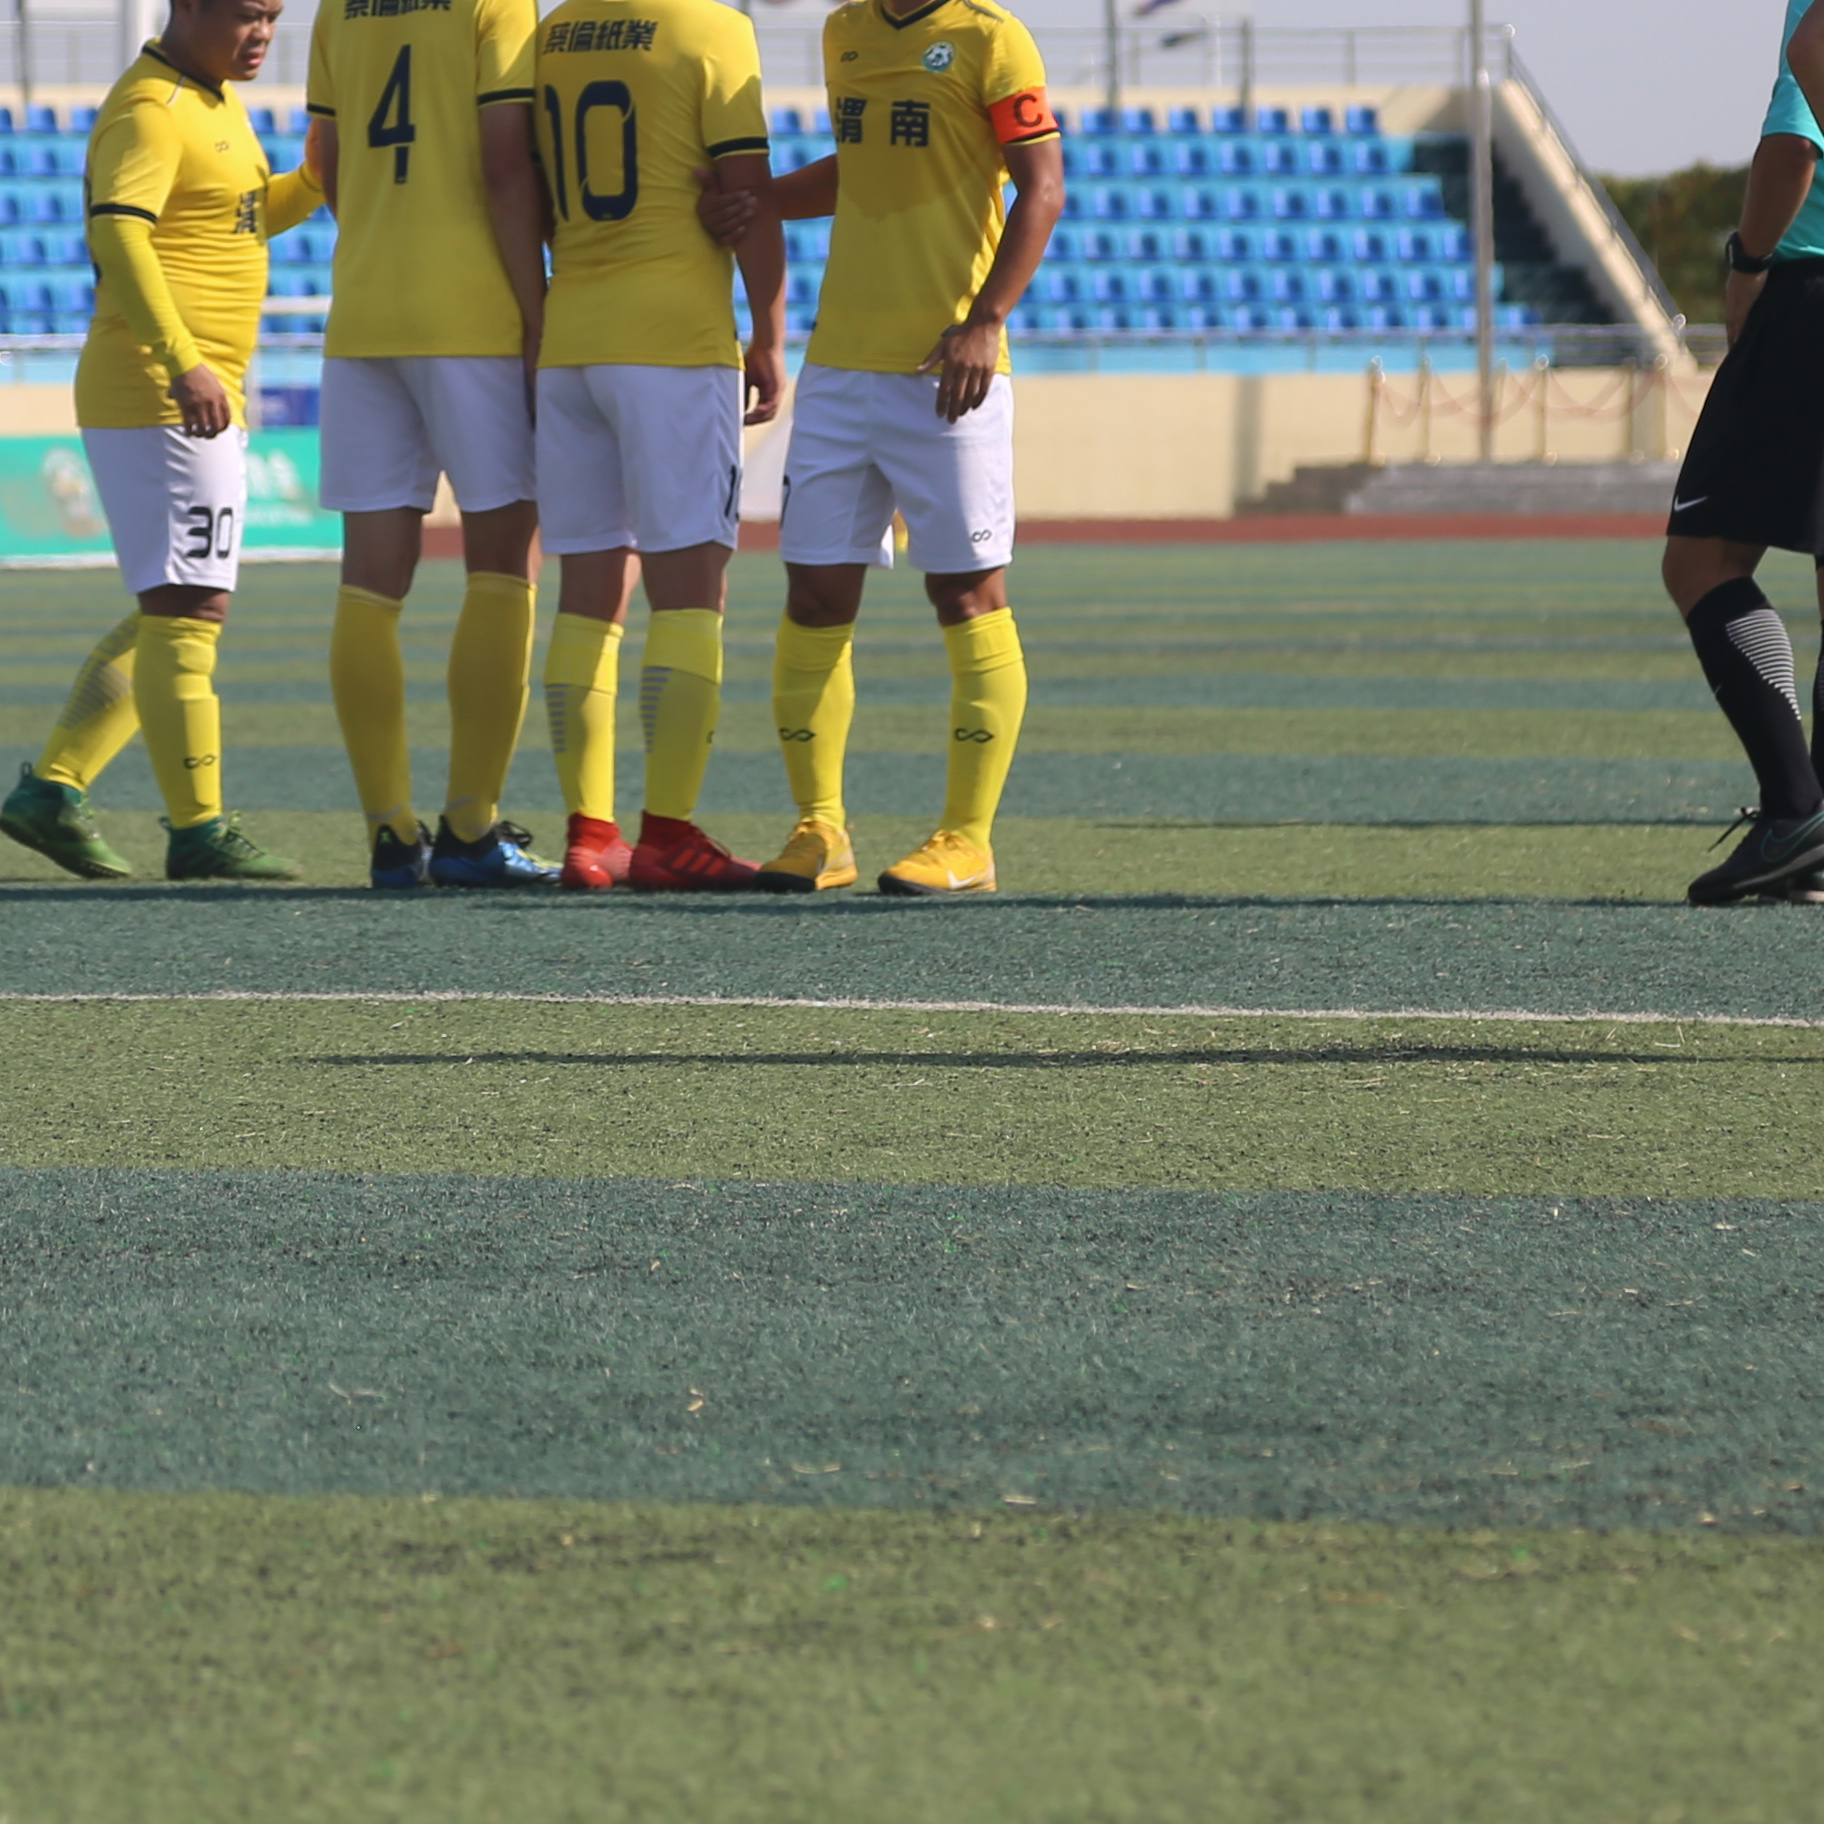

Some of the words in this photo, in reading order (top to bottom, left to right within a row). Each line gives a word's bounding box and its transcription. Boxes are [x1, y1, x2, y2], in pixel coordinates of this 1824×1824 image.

[367, 43, 416, 185] 4
[544, 79, 639, 222] 10
[1013, 94, 1043, 128] C
[185, 506, 234, 559] 30
